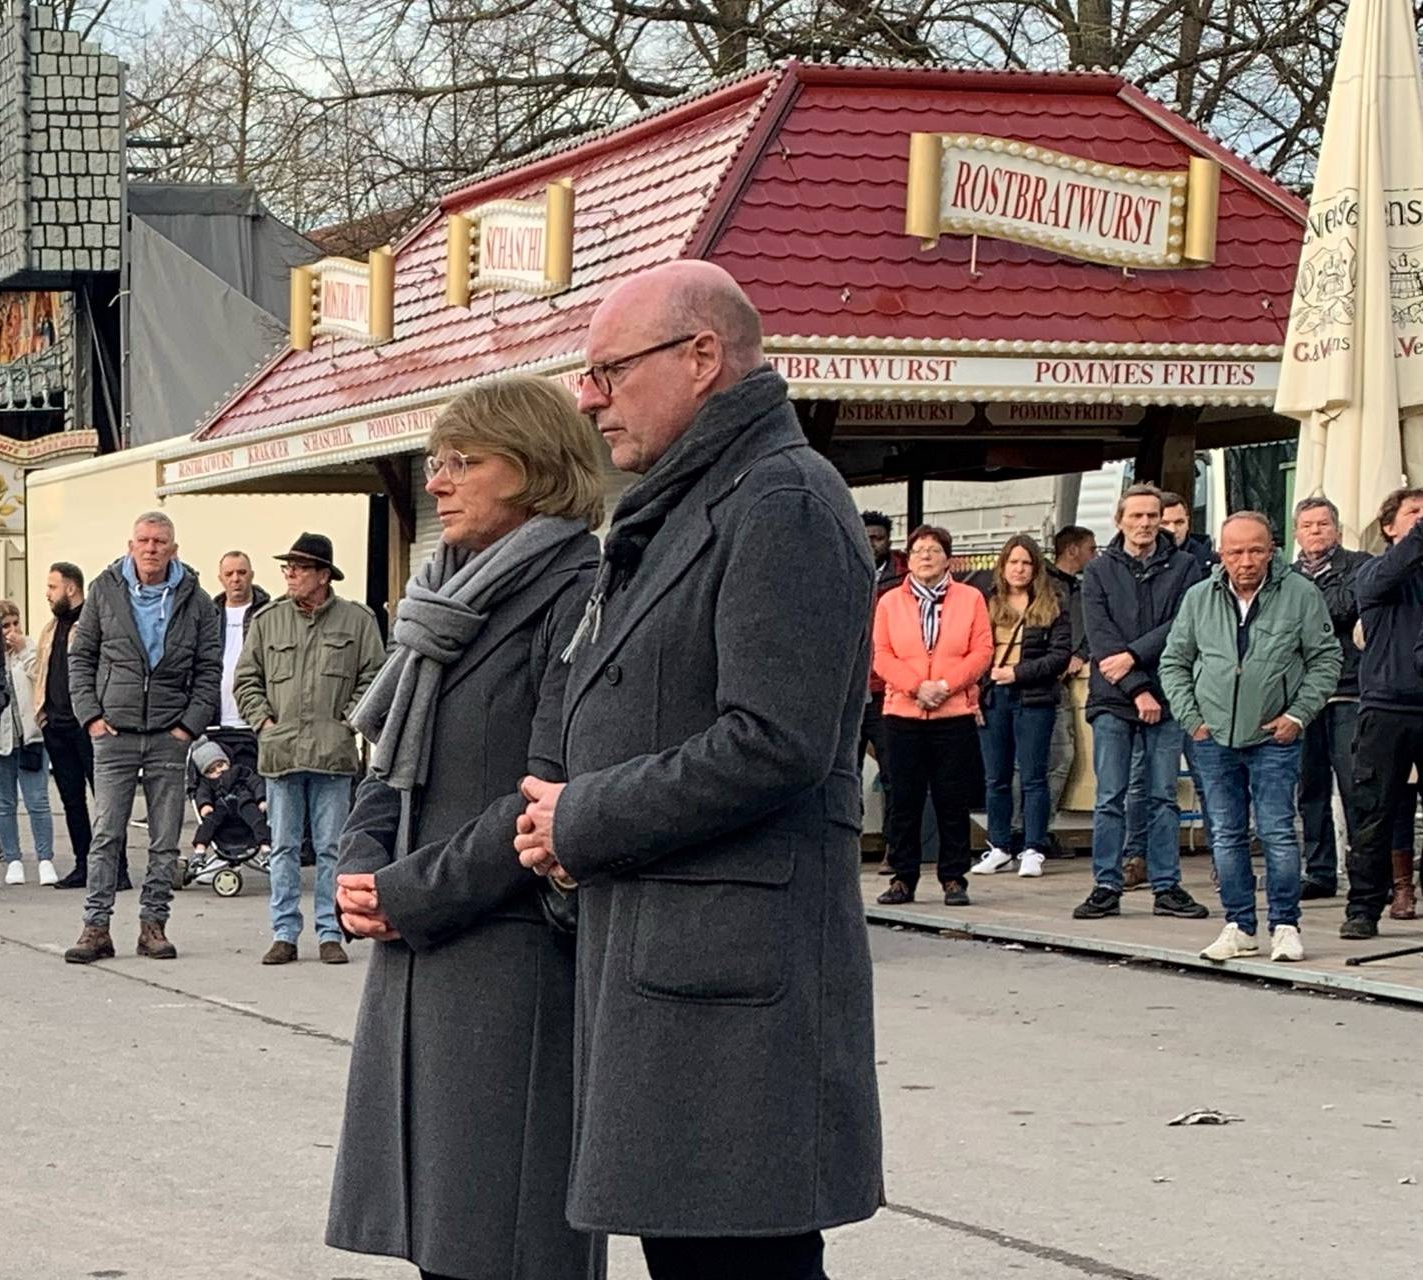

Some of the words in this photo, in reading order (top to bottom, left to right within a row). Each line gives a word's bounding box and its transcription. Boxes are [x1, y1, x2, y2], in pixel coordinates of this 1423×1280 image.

[951, 160, 1161, 245] ROSTBRATWURST
[764, 356, 957, 382] TBRATWURST
[1034, 361, 1154, 385] POMMES
[1162, 363, 1256, 386] FRITES
[1010, 404, 1071, 420] POMMES
[1075, 404, 1124, 420] FRITES
